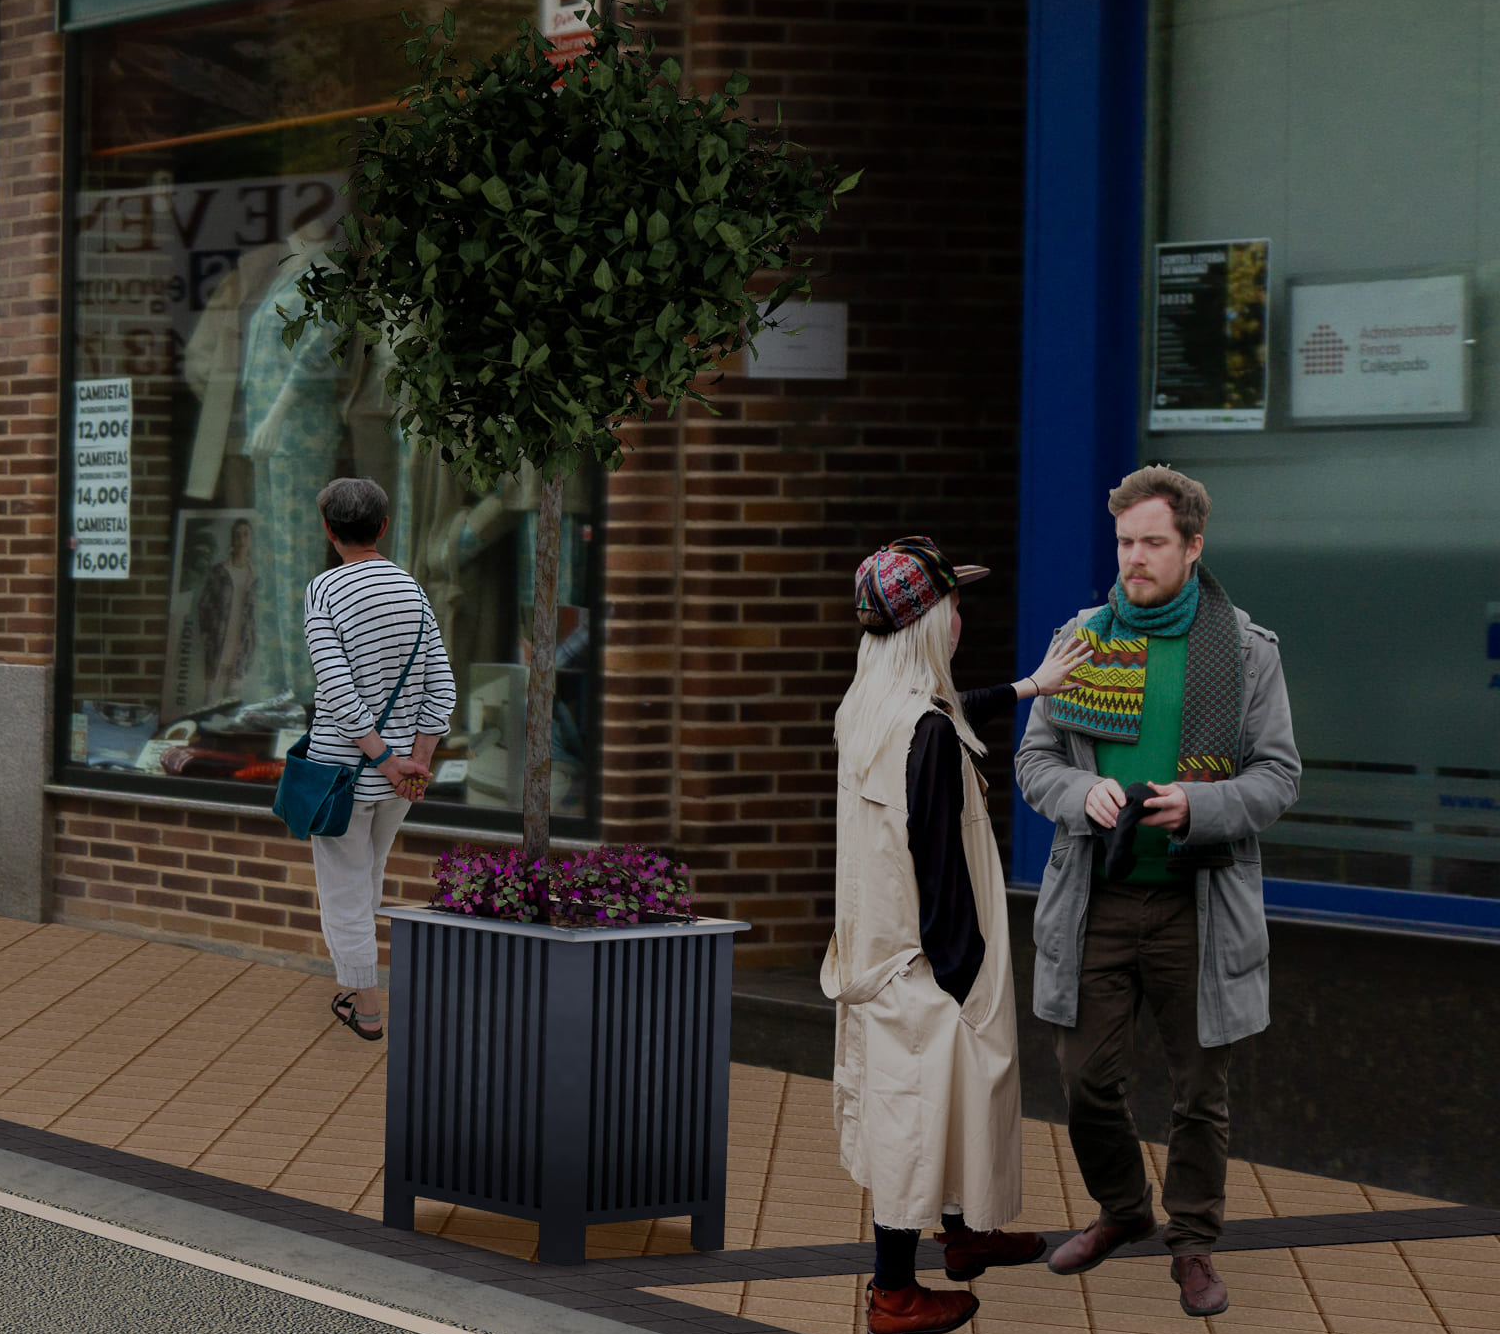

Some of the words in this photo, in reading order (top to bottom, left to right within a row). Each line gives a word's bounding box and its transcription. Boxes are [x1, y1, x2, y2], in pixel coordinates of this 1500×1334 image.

[1359, 323, 1457, 340] Administrador
[1359, 343, 1402, 356] Fincas
[1359, 357, 1430, 375] Colegiado
[78, 383, 130, 402] CAMISETAS
[77, 419, 130, 442] 12,00€
[77, 450, 129, 468] CAMISETAS
[76, 485, 129, 508] 14,00€
[76, 516, 128, 534] CAMISETAS
[76, 552, 129, 573] 16,00€
